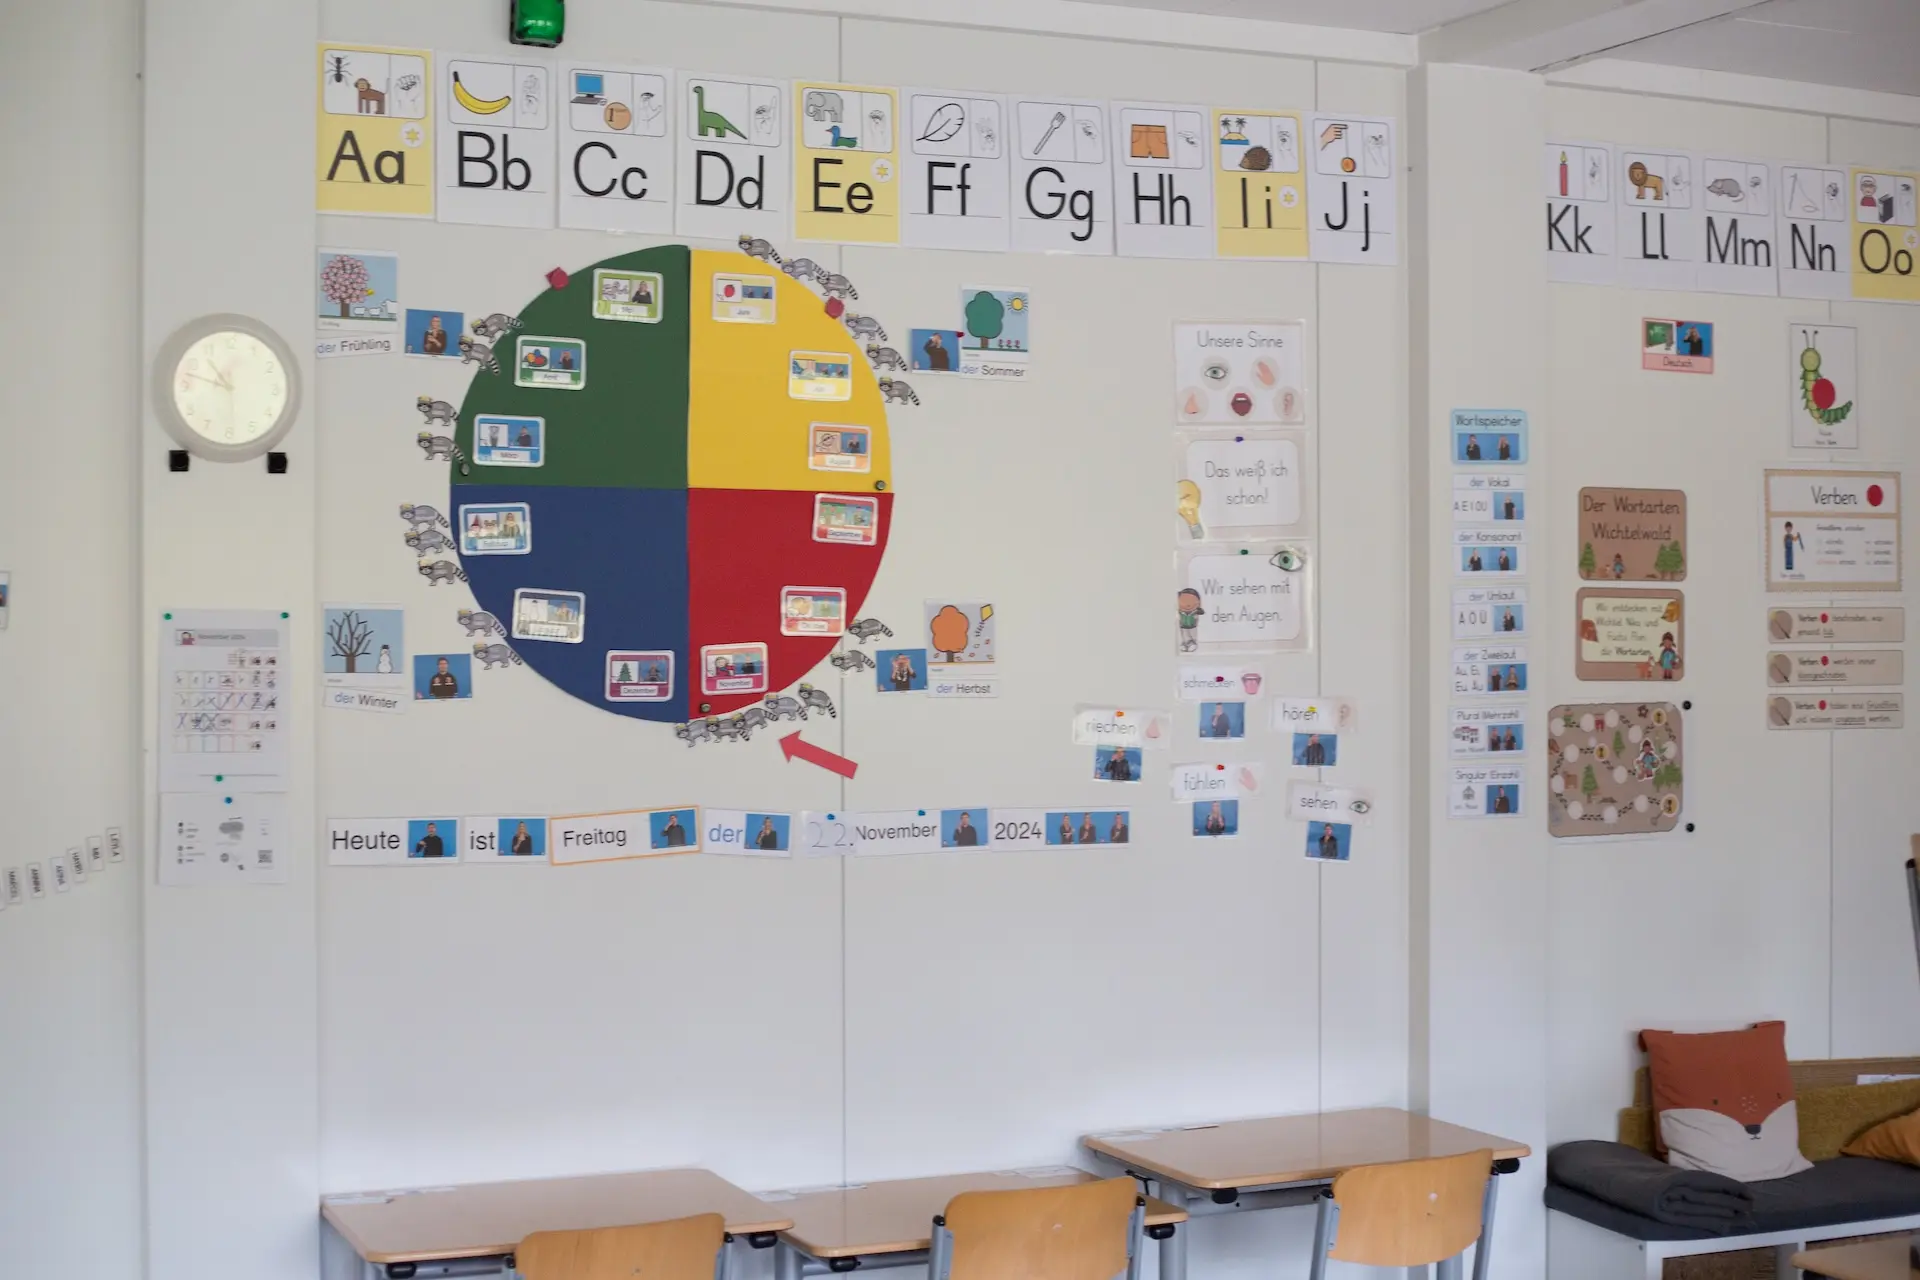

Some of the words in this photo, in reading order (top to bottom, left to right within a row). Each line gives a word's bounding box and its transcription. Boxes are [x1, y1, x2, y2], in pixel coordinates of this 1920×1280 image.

[327, 130, 405, 185] Aa
[457, 130, 532, 191] Bb
[574, 141, 648, 200] Cc
[696, 150, 764, 211] Dd
[814, 157, 874, 214] Ee
[927, 161, 971, 216] Ff
[1025, 167, 1094, 242] Gg
[1133, 172, 1191, 227] Hh
[1547, 202, 1593, 254] Kk
[1706, 216, 1771, 267] Mm
[1791, 223, 1836, 272] Nn
[1859, 228, 1913, 276] Oo
[317, 343, 336, 354] der
[340, 338, 391, 351] Frühling
[1196, 330, 1243, 347] Unsere
[1247, 330, 1283, 348] Sinne
[962, 365, 978, 374] der
[981, 365, 1026, 377] Sommer
[1455, 415, 1522, 430] Wortspeicher
[1205, 460, 1230, 478] Das
[1235, 459, 1266, 484] weiß
[1270, 459, 1288, 477] ich
[1488, 478, 1510, 487] Vokal
[1226, 487, 1269, 505] schon!
[1583, 495, 1606, 513] Der
[1614, 496, 1680, 515] Wortarten
[1811, 486, 1858, 505] Verben
[1476, 532, 1522, 542] Konsonant
[1592, 523, 1672, 541] Wichtelwald
[1201, 578, 1224, 596] Wir
[1230, 577, 1267, 594] sehen
[1271, 577, 1290, 594] mit
[1487, 591, 1515, 601] Umlaut
[1211, 606, 1234, 623] den
[1238, 606, 1282, 629] Augen.
[936, 683, 953, 694] der
[957, 683, 991, 694] Herbst
[334, 692, 355, 704] der
[358, 694, 398, 709] Winter
[1282, 703, 1318, 721] hören
[1086, 719, 1136, 736] riechen
[1184, 773, 1226, 791] fühlen
[1300, 794, 1338, 811] sehen
[331, 830, 400, 851] Heute
[563, 827, 628, 850] Freitag
[708, 824, 744, 843] der
[855, 823, 938, 842] November
[994, 821, 1043, 841] 2024
[469, 831, 496, 851] ist
